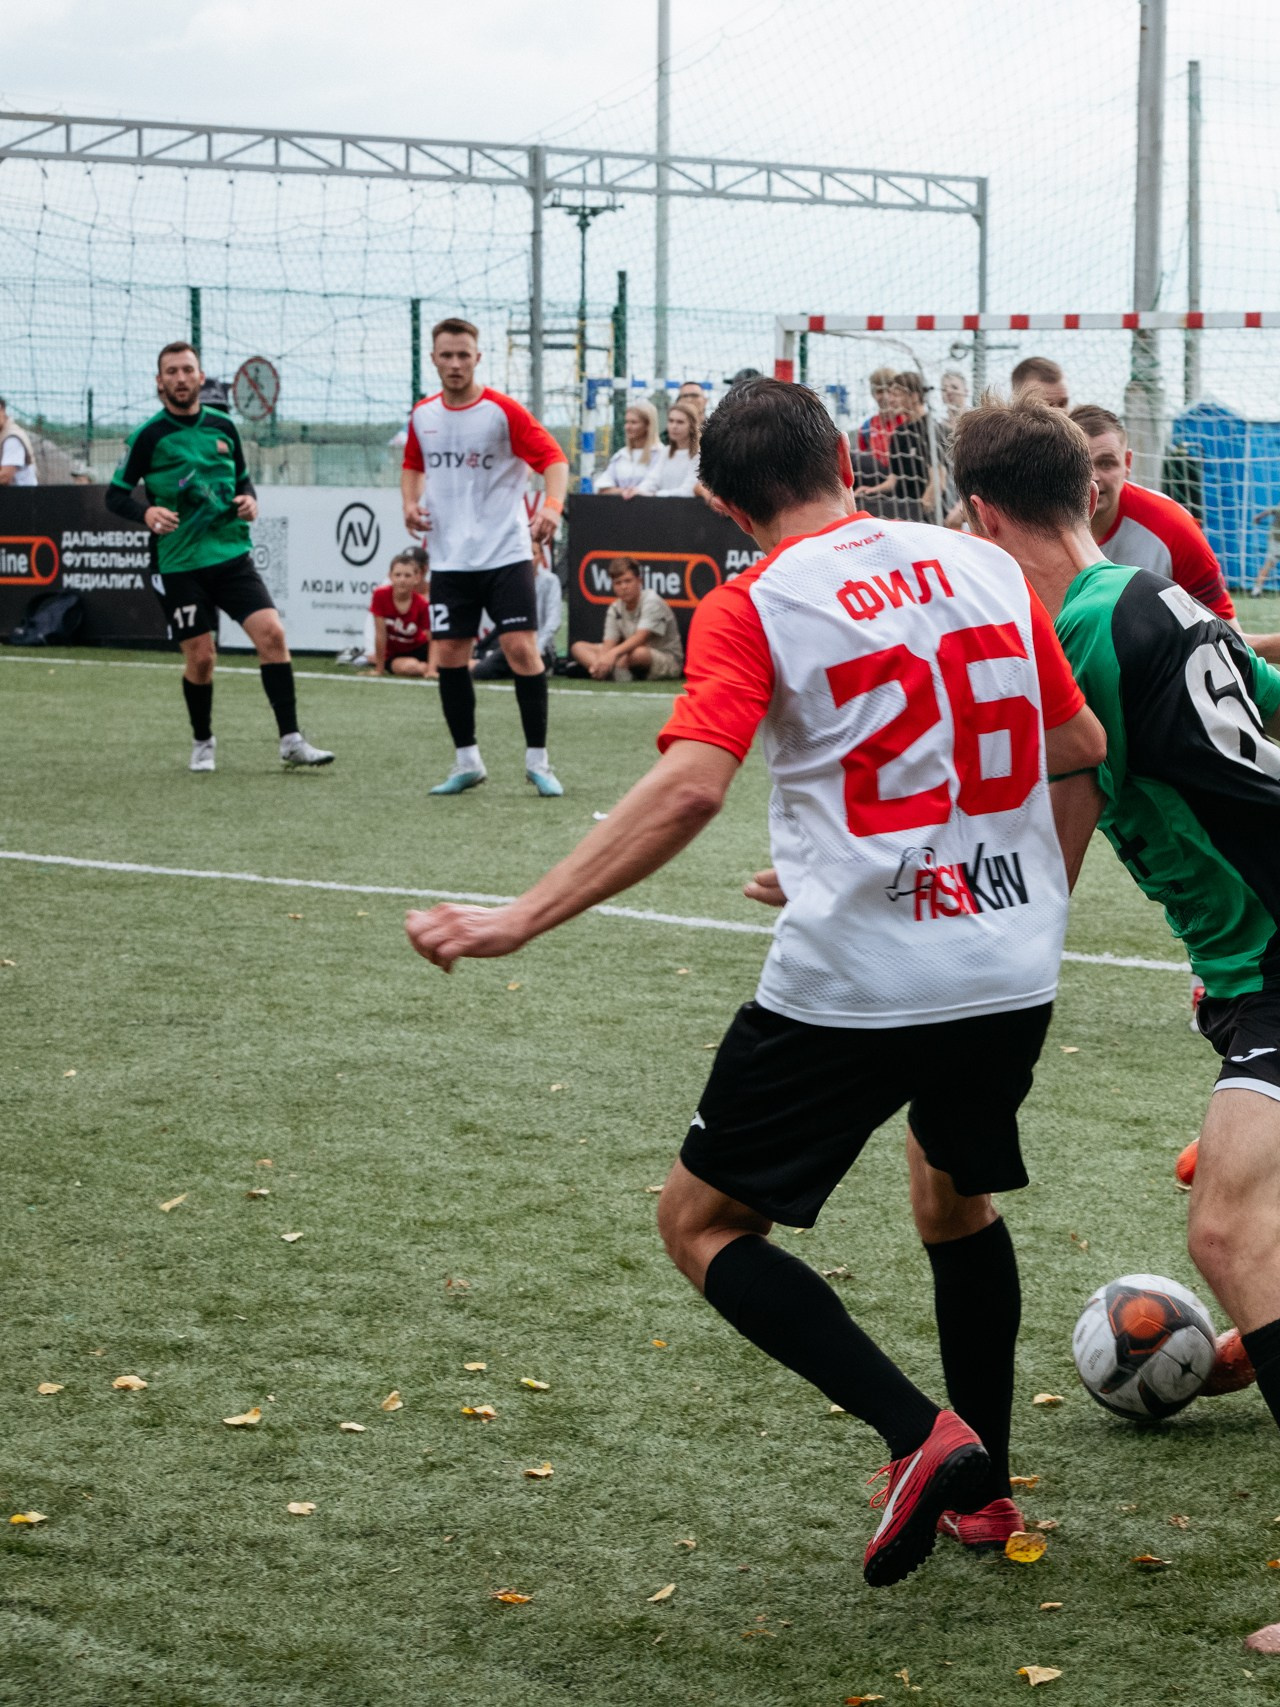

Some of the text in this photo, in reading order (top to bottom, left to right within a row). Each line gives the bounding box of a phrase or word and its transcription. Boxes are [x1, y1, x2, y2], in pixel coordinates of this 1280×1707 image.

[61, 531, 151, 549] ДАЛЬНЕВОСТ
[833, 531, 885, 551] MAVEX
[725, 549, 767, 571] ДАЛ
[62, 573, 145, 591] МЕДИАЛИГА
[836, 559, 955, 621] ФИЛ
[173, 604, 197, 629] 17
[824, 621, 1040, 838] 26
